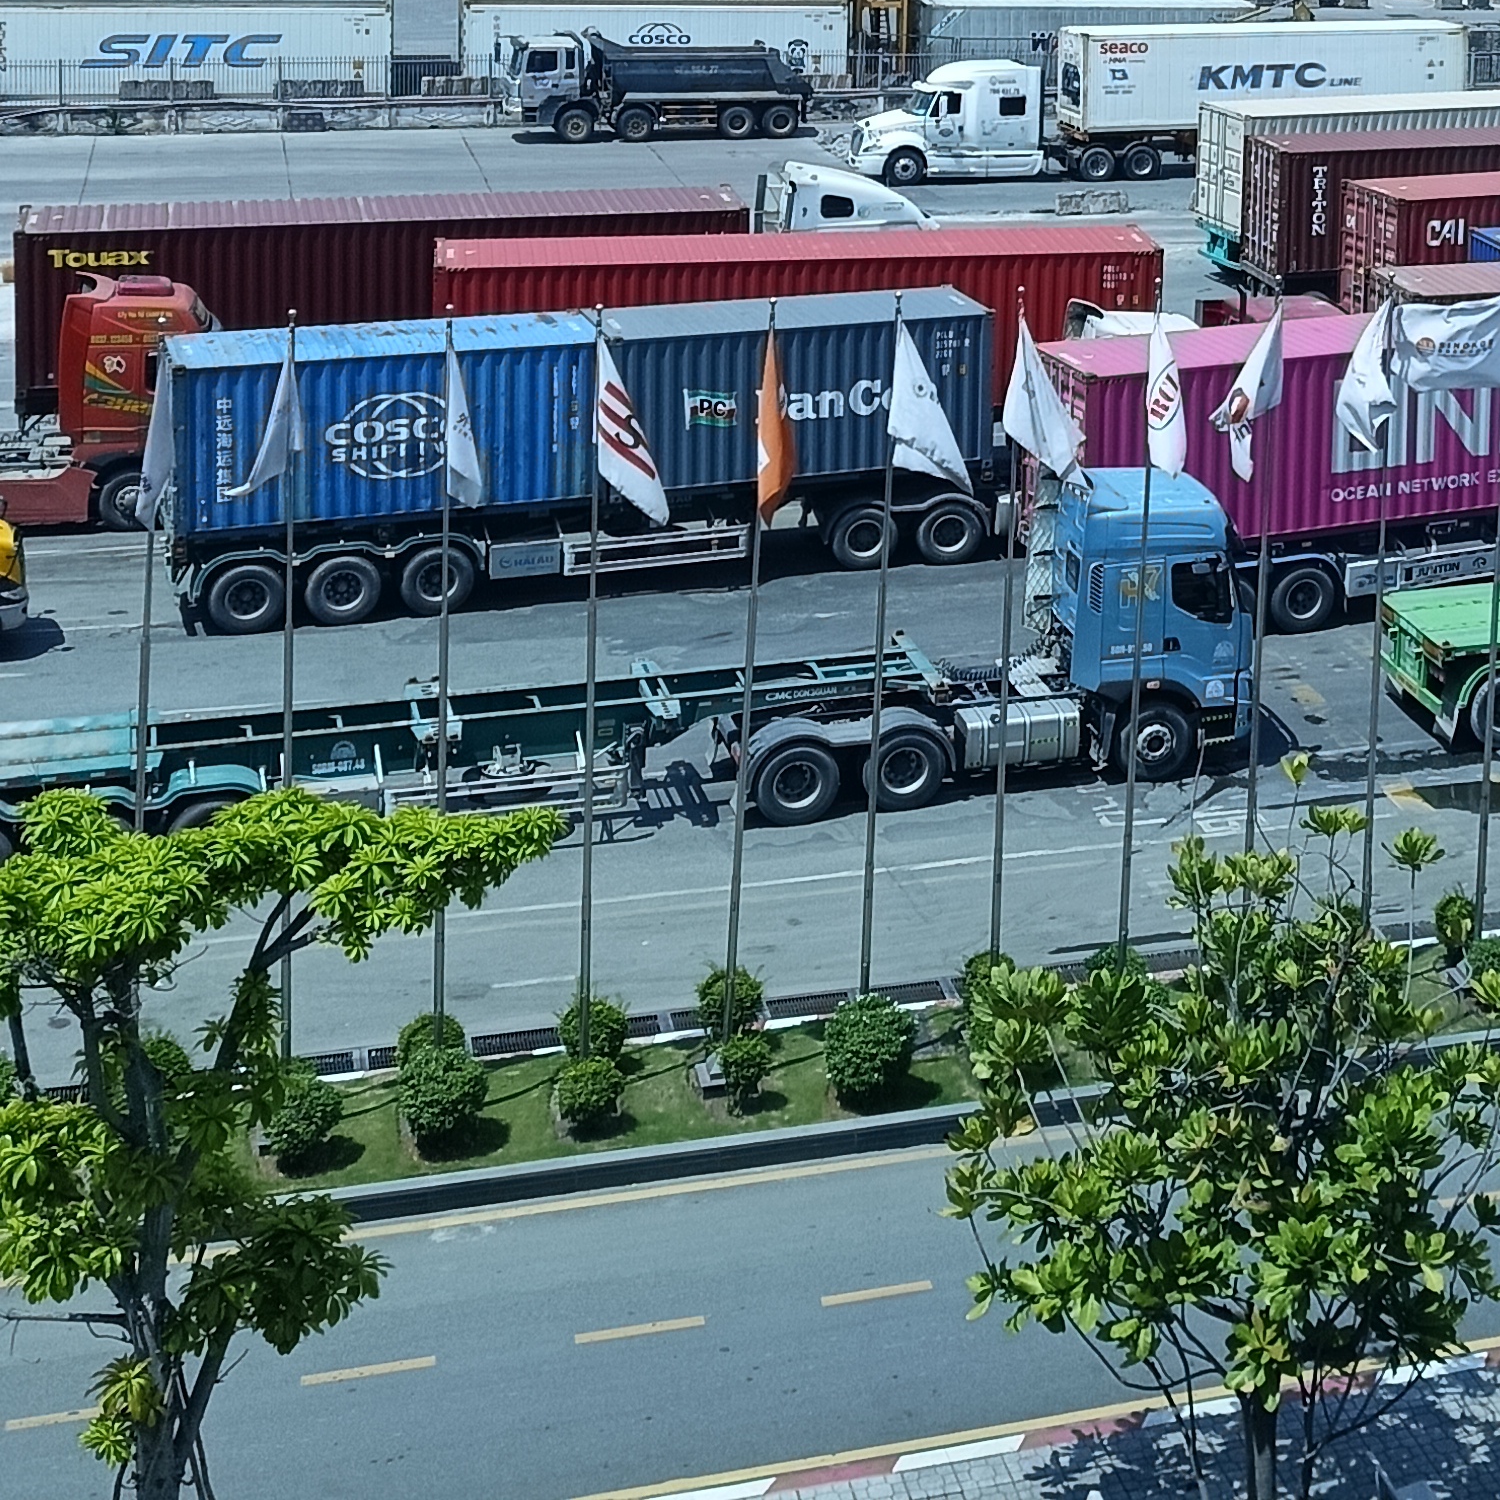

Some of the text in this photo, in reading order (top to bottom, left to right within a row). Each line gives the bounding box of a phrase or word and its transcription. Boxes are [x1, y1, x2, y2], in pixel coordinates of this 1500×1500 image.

[79, 34, 283, 69] SITC
[628, 33, 691, 45] COSCO
[1100, 42, 1149, 54] seaco
[1198, 62, 1362, 90] KMTC LINE
[1311, 166, 1328, 236] TRITON
[1426, 218, 1465, 247] CAI
[47, 249, 153, 268] Touax
[699, 399, 727, 418] PC
[325, 417, 446, 446] COSC
[1331, 482, 1391, 502] OCEAN
[1398, 471, 1480, 495] NETWORK
